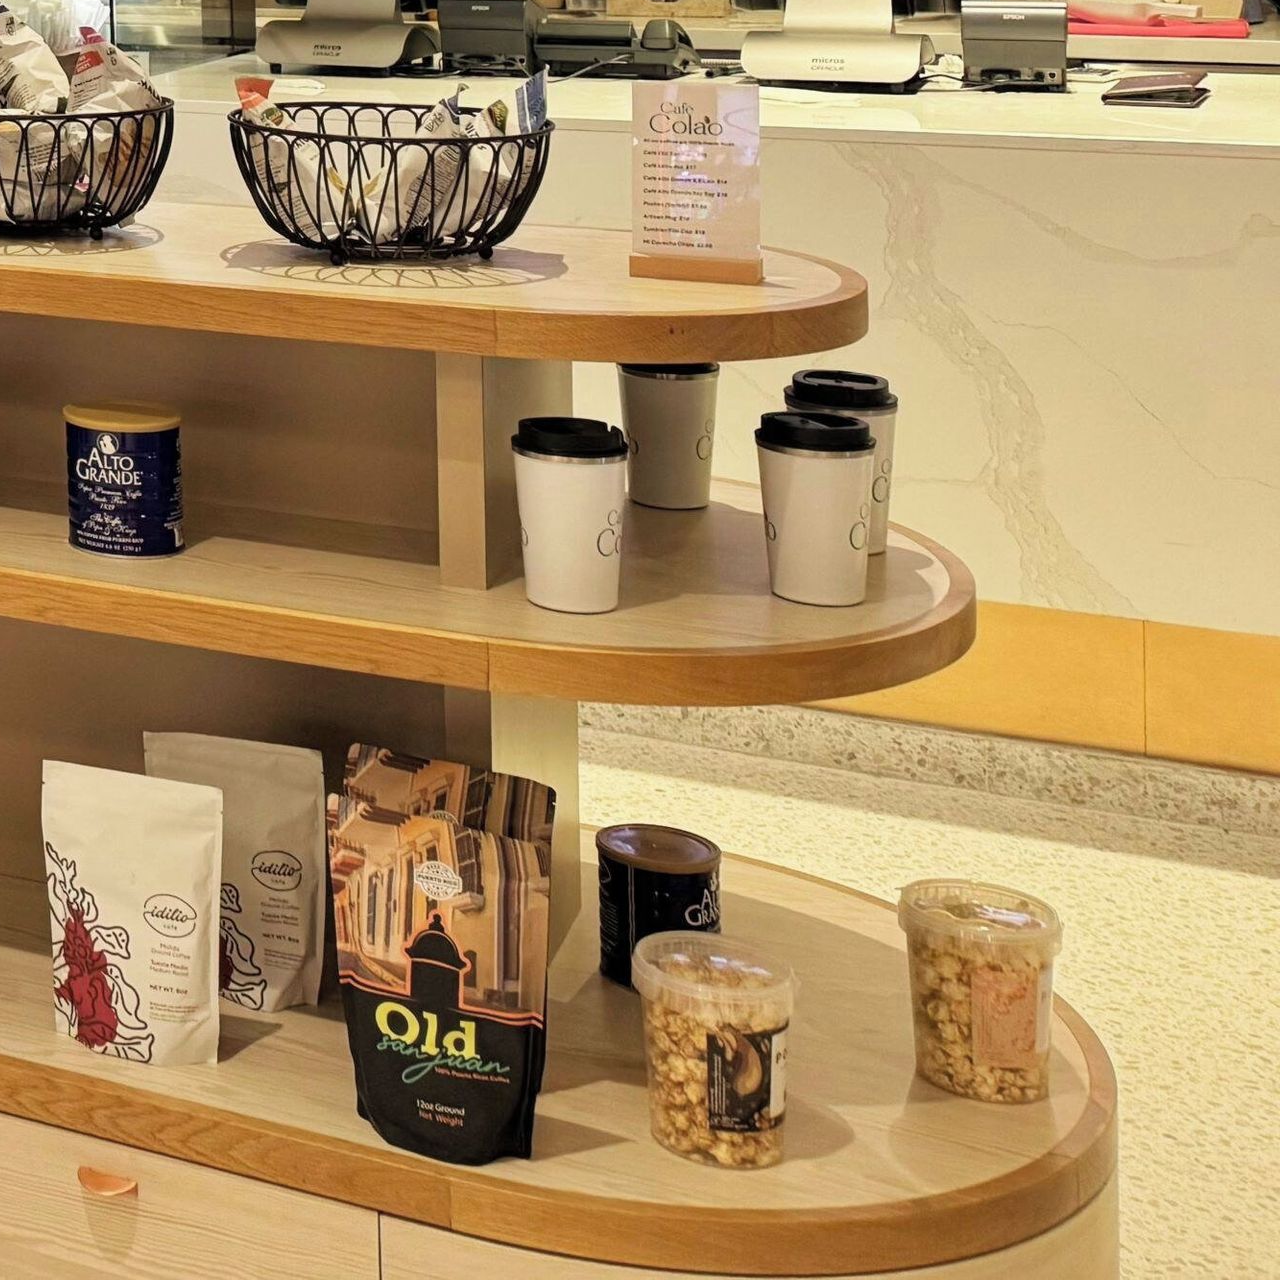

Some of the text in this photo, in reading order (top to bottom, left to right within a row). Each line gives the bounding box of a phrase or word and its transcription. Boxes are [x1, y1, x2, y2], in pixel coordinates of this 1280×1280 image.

[811, 56, 845, 64] micros
[649, 113, 723, 136] Colao
[88, 447, 134, 471] ALTO
[76, 458, 142, 485] GRANDE
[375, 1001, 480, 1060] Old
[417, 1098, 465, 1116] 12oz Ground
